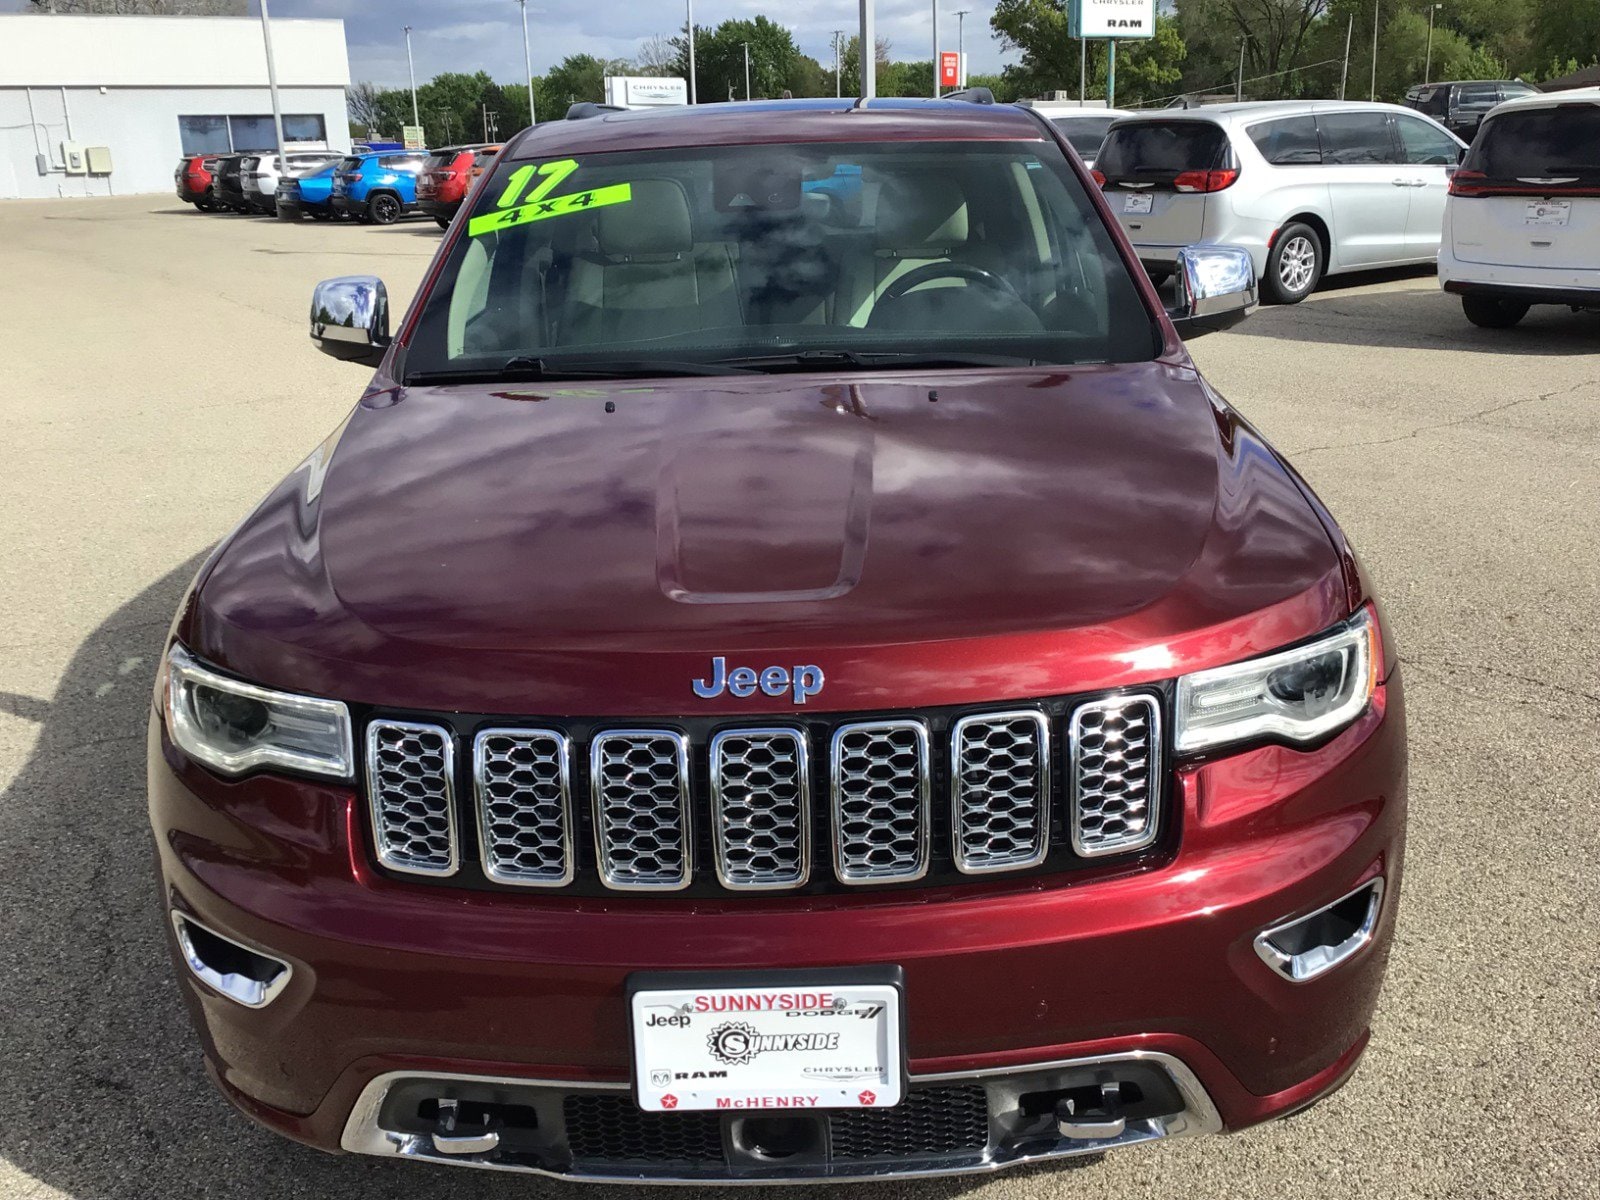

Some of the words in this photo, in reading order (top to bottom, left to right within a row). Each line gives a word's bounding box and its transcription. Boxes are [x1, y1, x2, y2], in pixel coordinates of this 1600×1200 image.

[1107, 19, 1142, 28] RAM
[497, 159, 579, 207] 17
[692, 656, 825, 704] Jeep
[695, 993, 834, 1012] SUNNYSIDE
[646, 1013, 691, 1028] Jeep
[785, 1010, 866, 1018] DODGE
[721, 1029, 840, 1057] SUNNYSIDE
[675, 1070, 728, 1080] RAM
[803, 1066, 885, 1074] CHRYSLER
[716, 1096, 820, 1109] McHENRY
